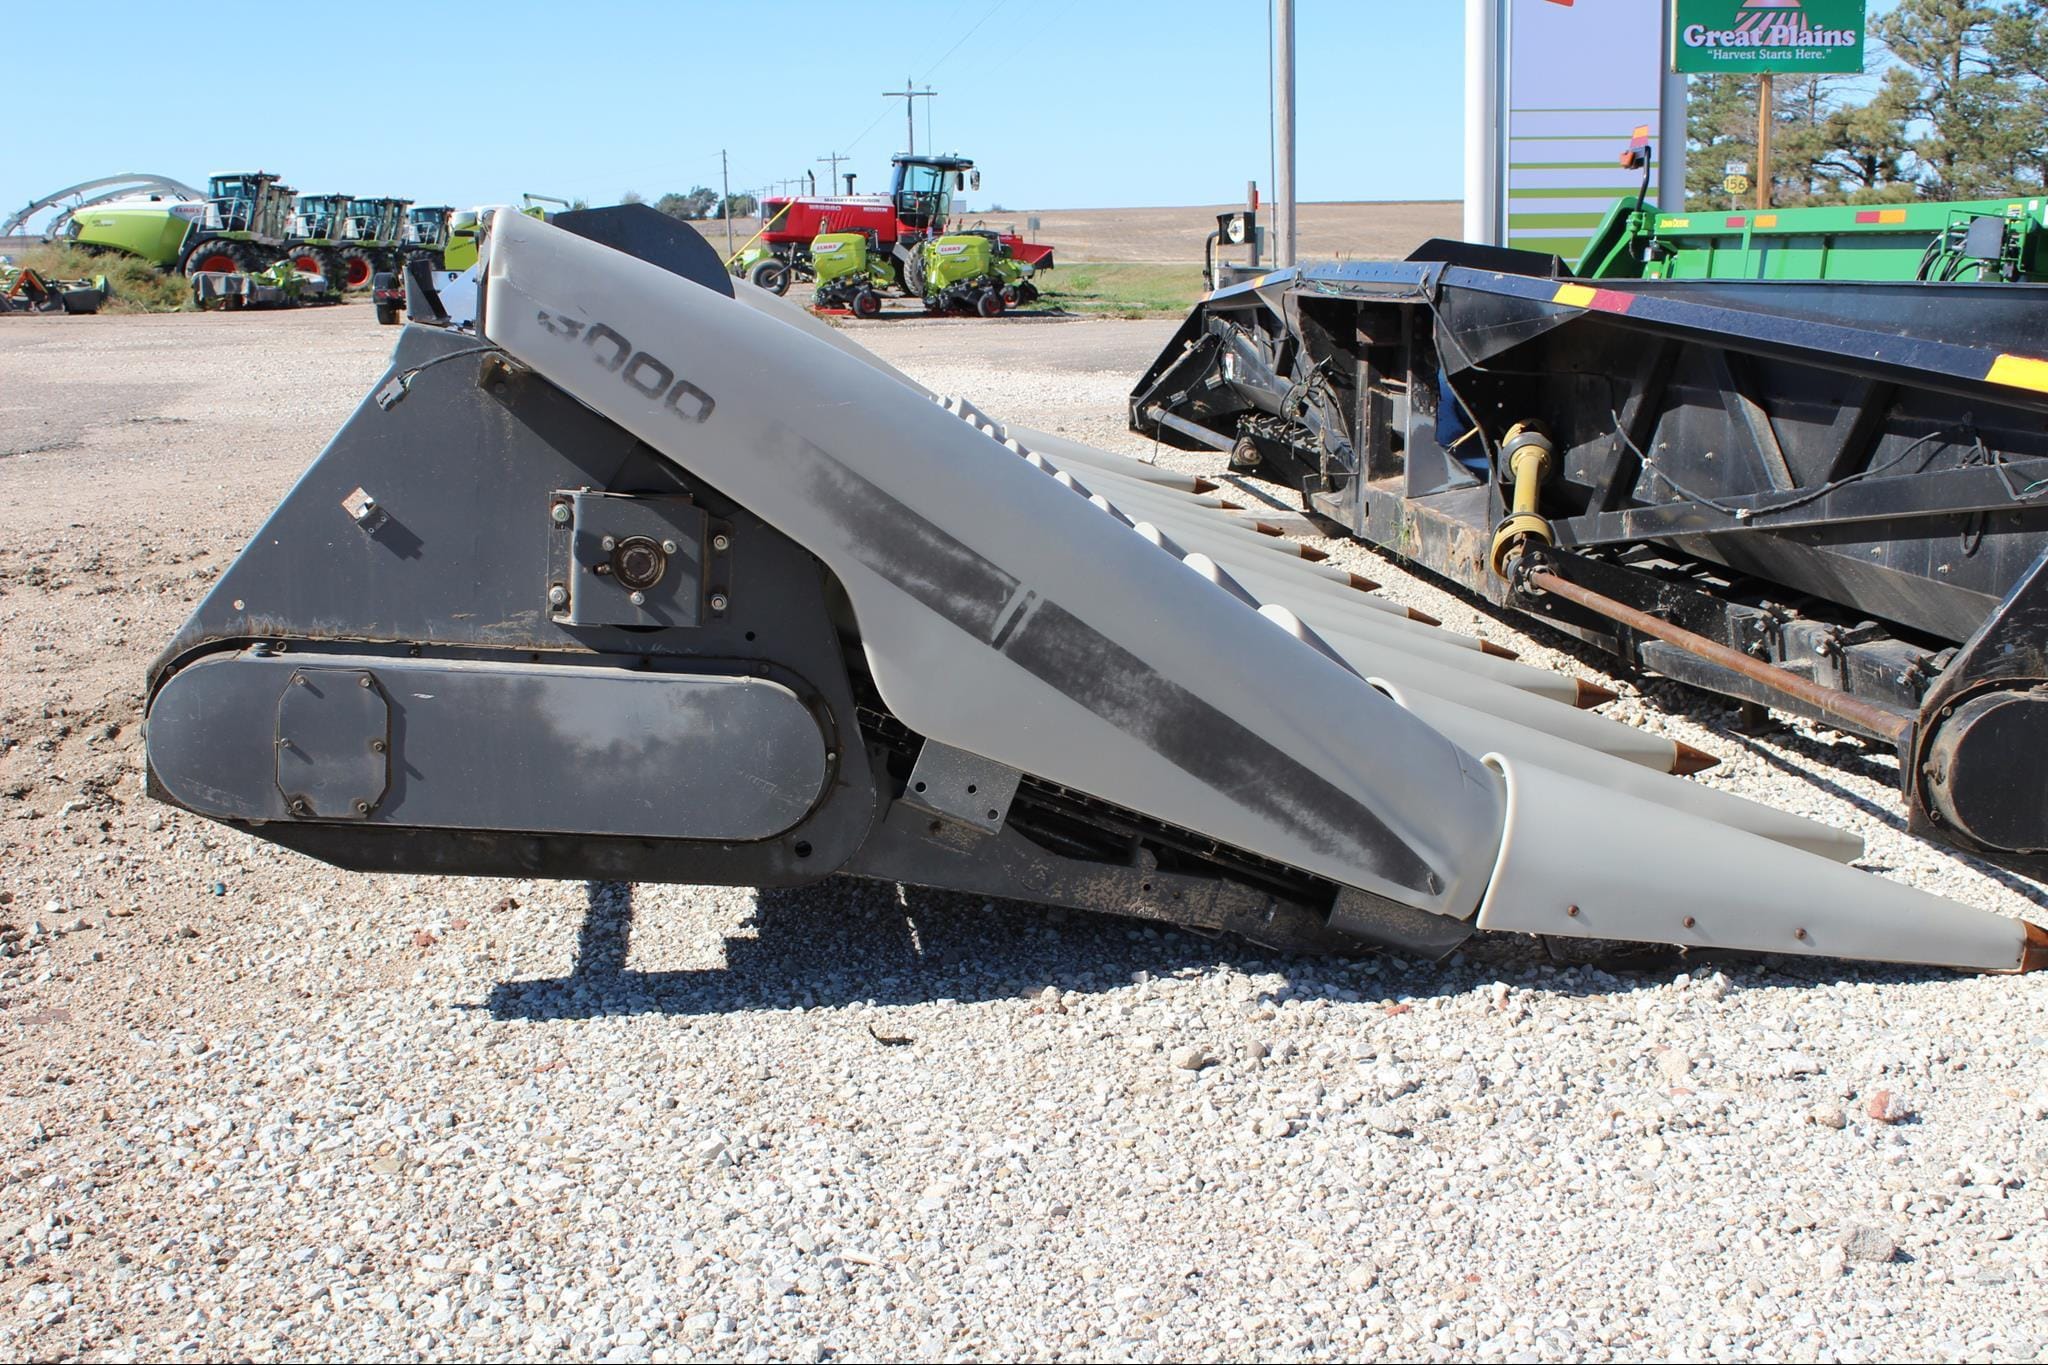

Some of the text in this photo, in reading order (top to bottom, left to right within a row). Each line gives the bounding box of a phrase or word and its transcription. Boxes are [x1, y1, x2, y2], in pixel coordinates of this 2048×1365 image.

[1683, 24, 1857, 47] Great Plains
[1707, 48, 1832, 60] “Harvest Starts Here.”
[1726, 178, 1746, 190] 156
